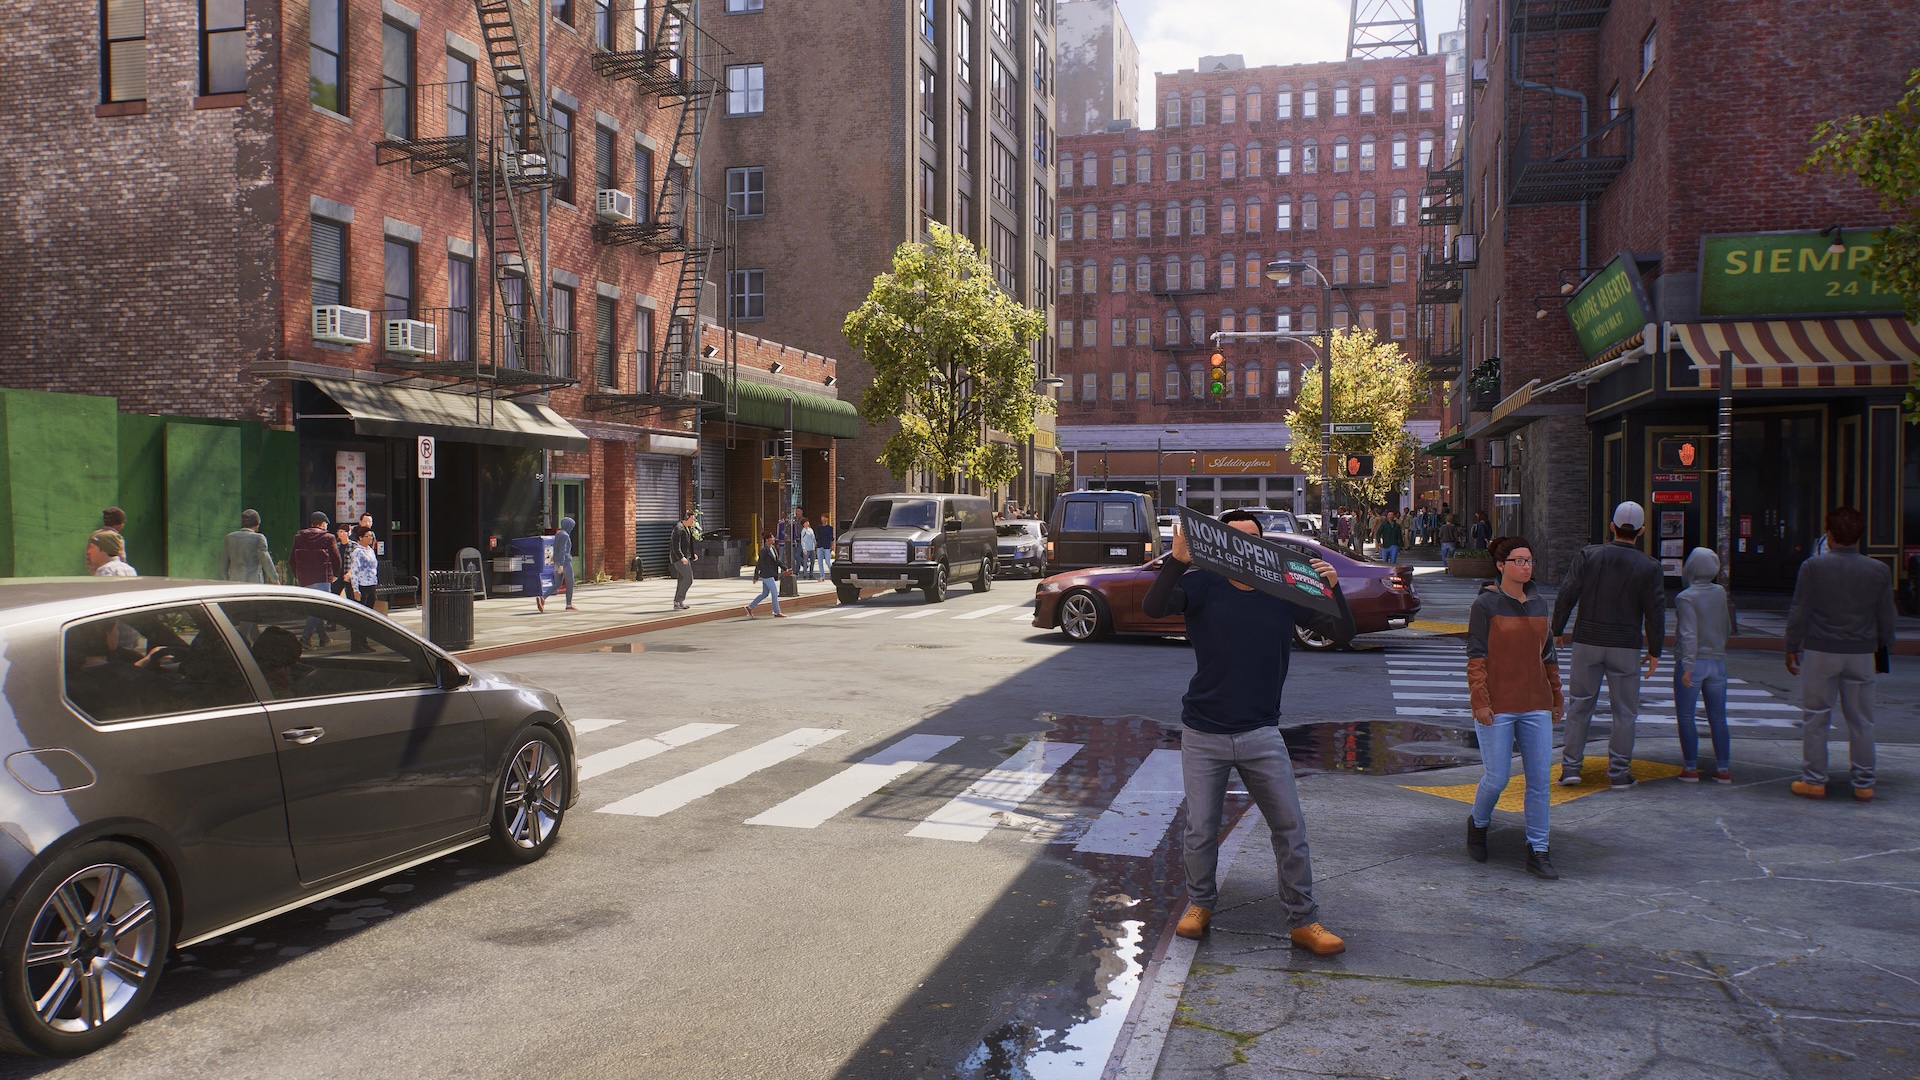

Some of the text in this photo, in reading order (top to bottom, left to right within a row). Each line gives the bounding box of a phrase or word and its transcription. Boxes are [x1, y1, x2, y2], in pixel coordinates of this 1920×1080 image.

[1597, 271, 1632, 310] ABIERTO
[1825, 281, 1859, 297] 24
[1208, 456, 1271, 473] Addingtons
[1187, 517, 1282, 572] NOW OPEN!
[1192, 539, 1283, 582] BUY 1 GET 1 FREE!
[1290, 562, 1308, 573] Back
[1288, 571, 1325, 590] TOPPINGS
